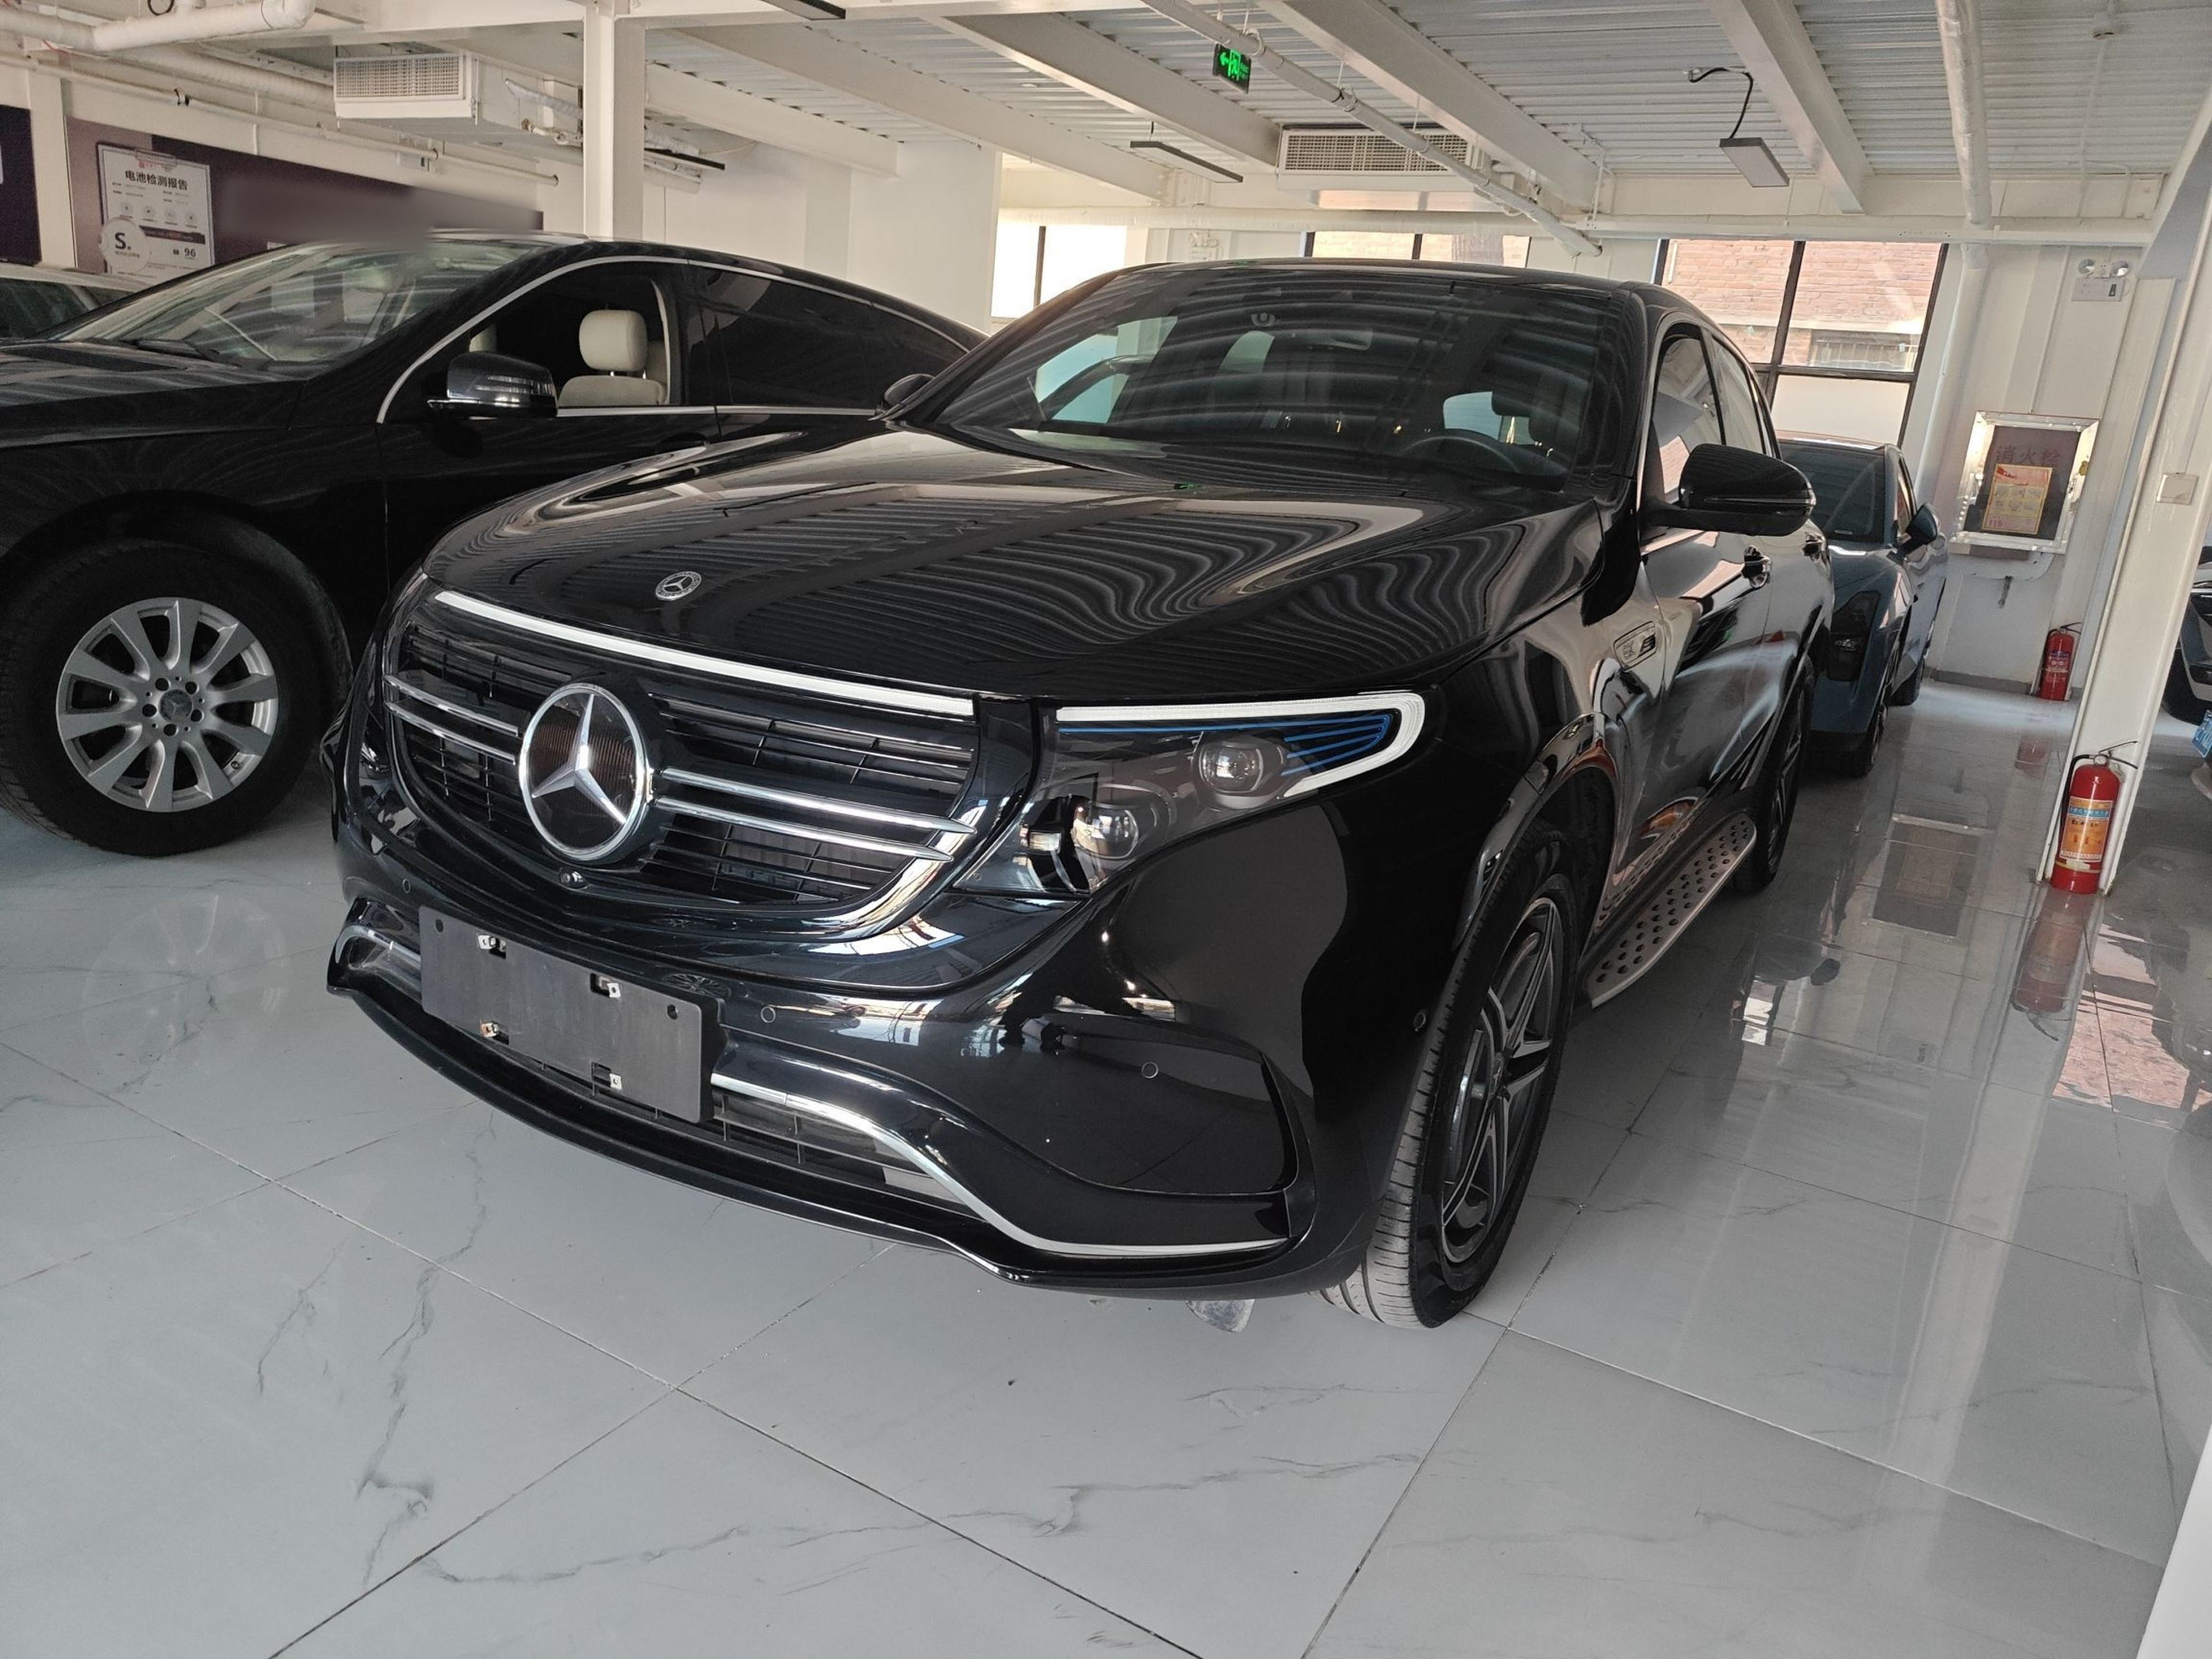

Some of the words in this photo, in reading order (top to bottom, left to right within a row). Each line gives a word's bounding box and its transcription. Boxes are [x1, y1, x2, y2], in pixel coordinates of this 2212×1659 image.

[125, 171, 187, 191] 电池检测报告
[184, 248, 196, 257] 96
